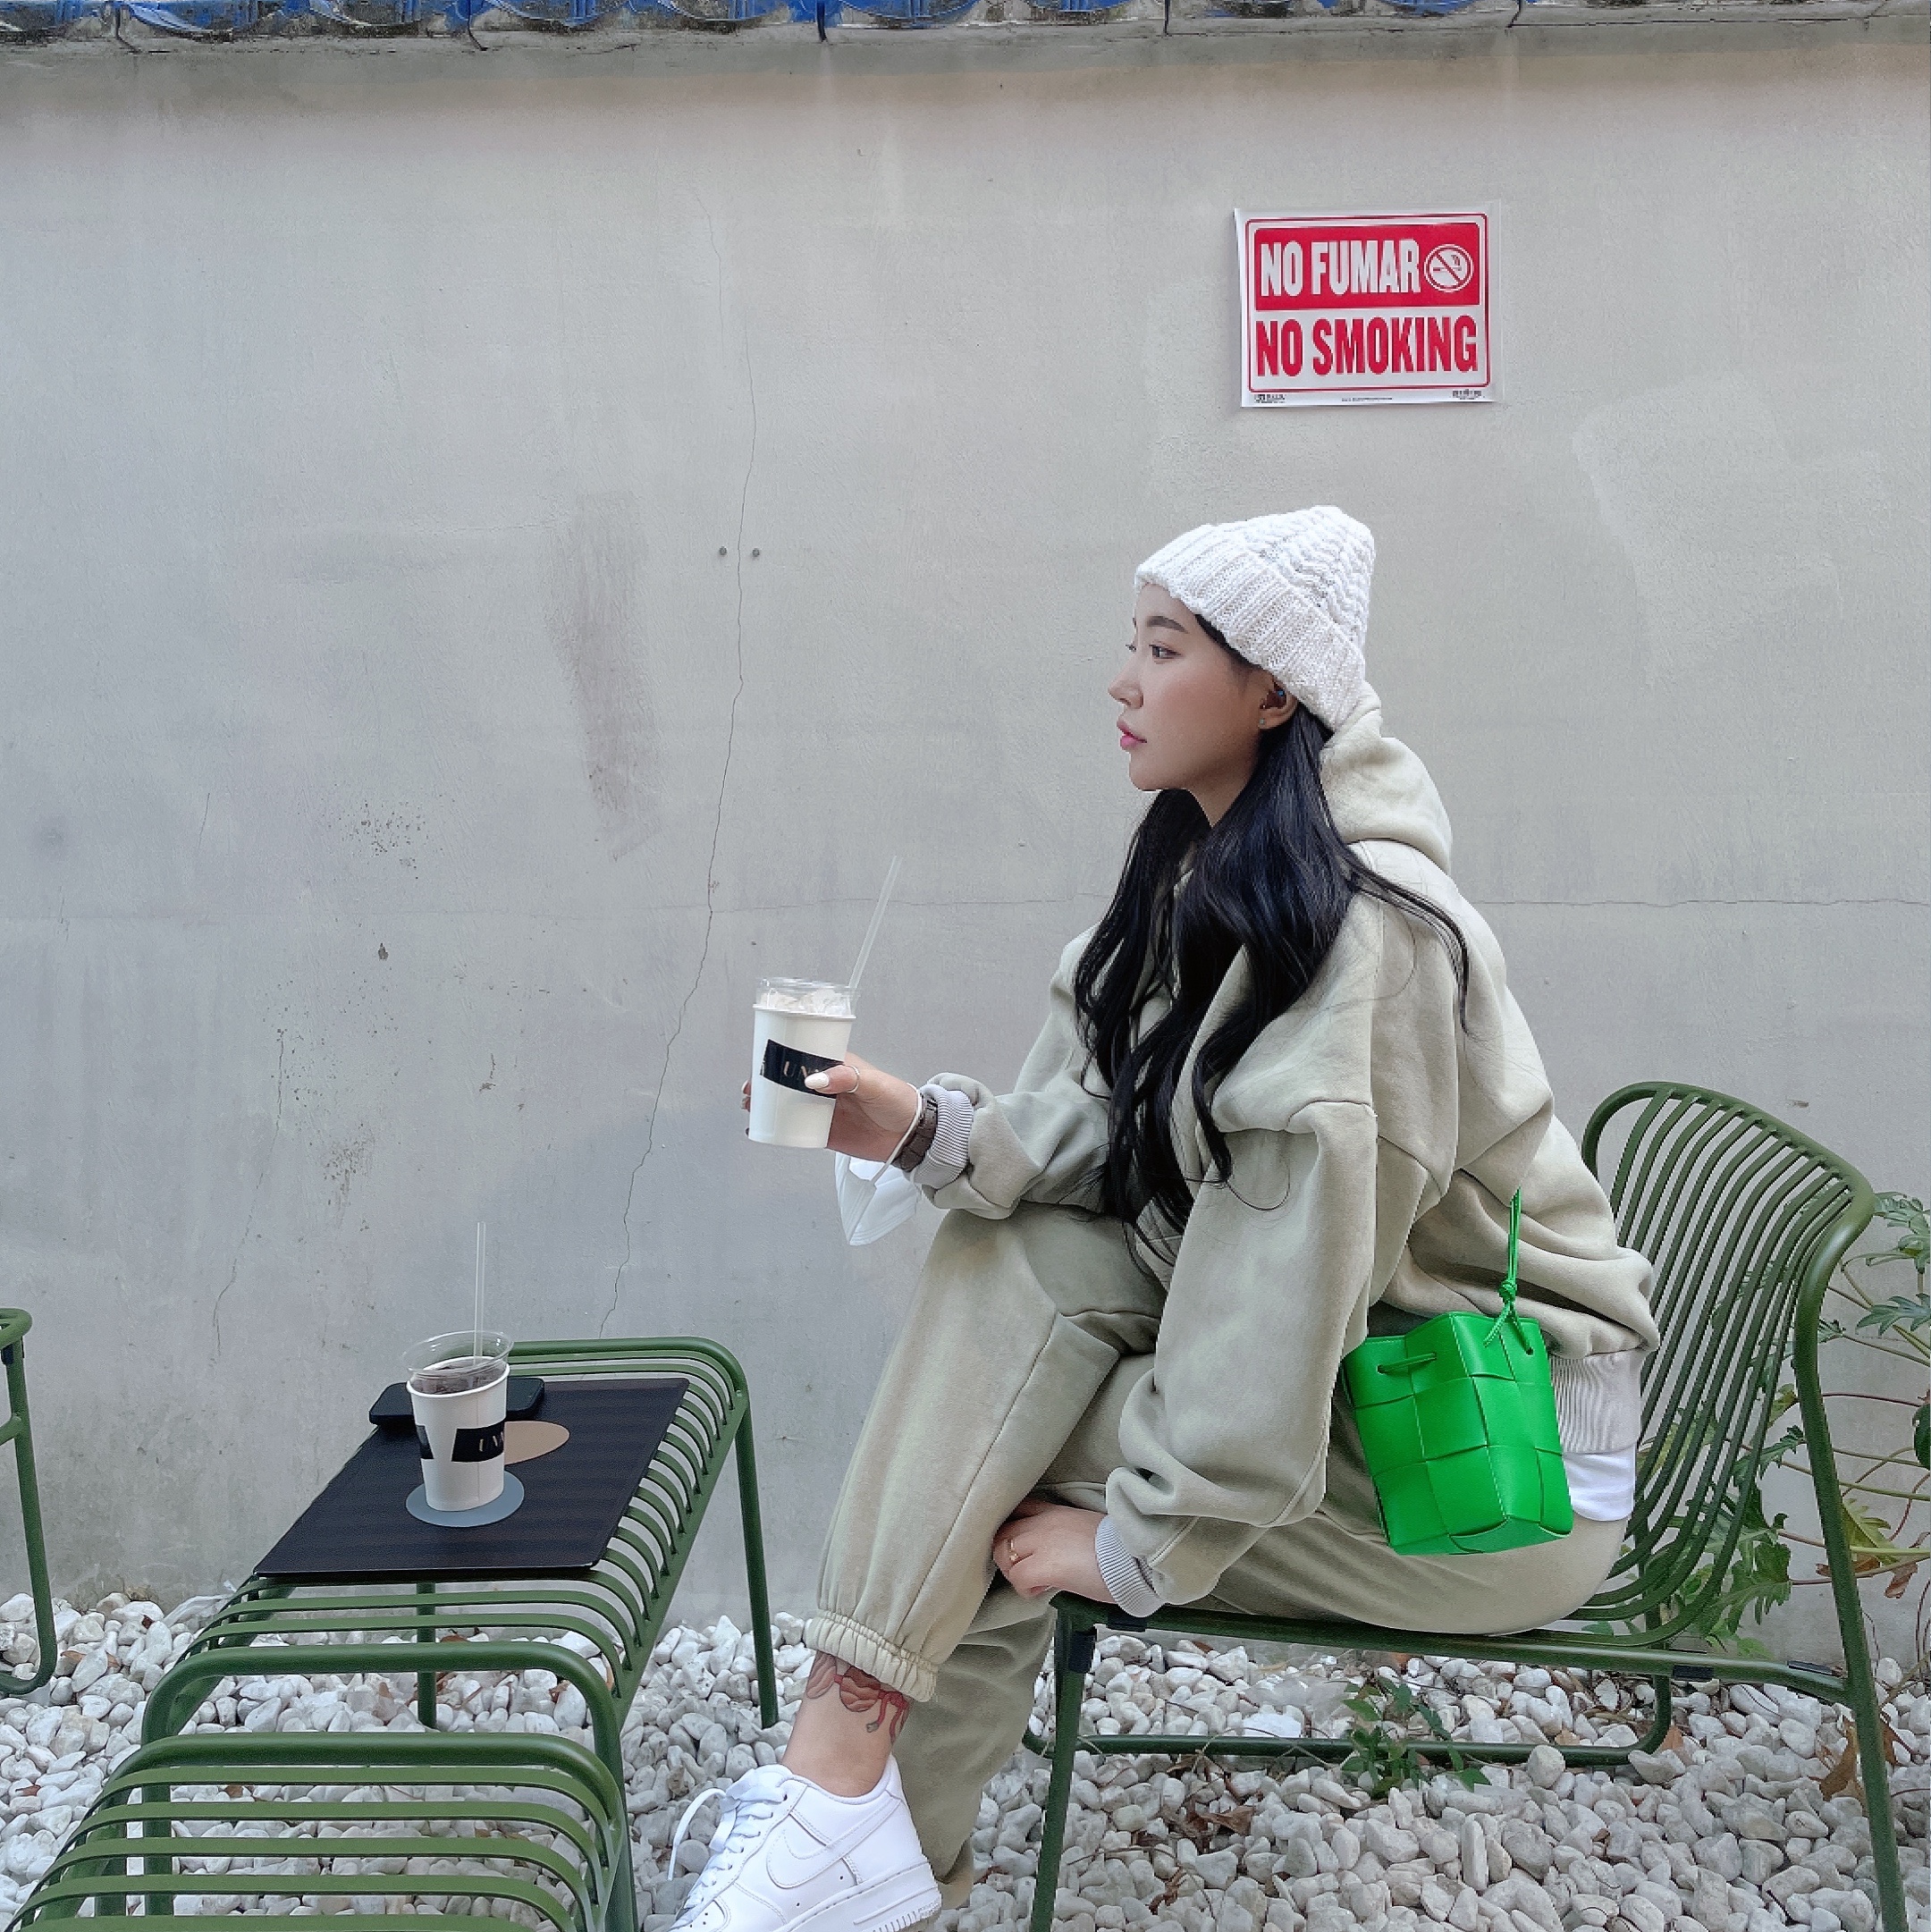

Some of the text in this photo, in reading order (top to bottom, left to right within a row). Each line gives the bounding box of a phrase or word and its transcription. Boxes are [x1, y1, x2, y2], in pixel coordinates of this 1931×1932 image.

[1261, 239, 1421, 297] NO FUMAR
[1256, 315, 1479, 377] NO SMOKING
